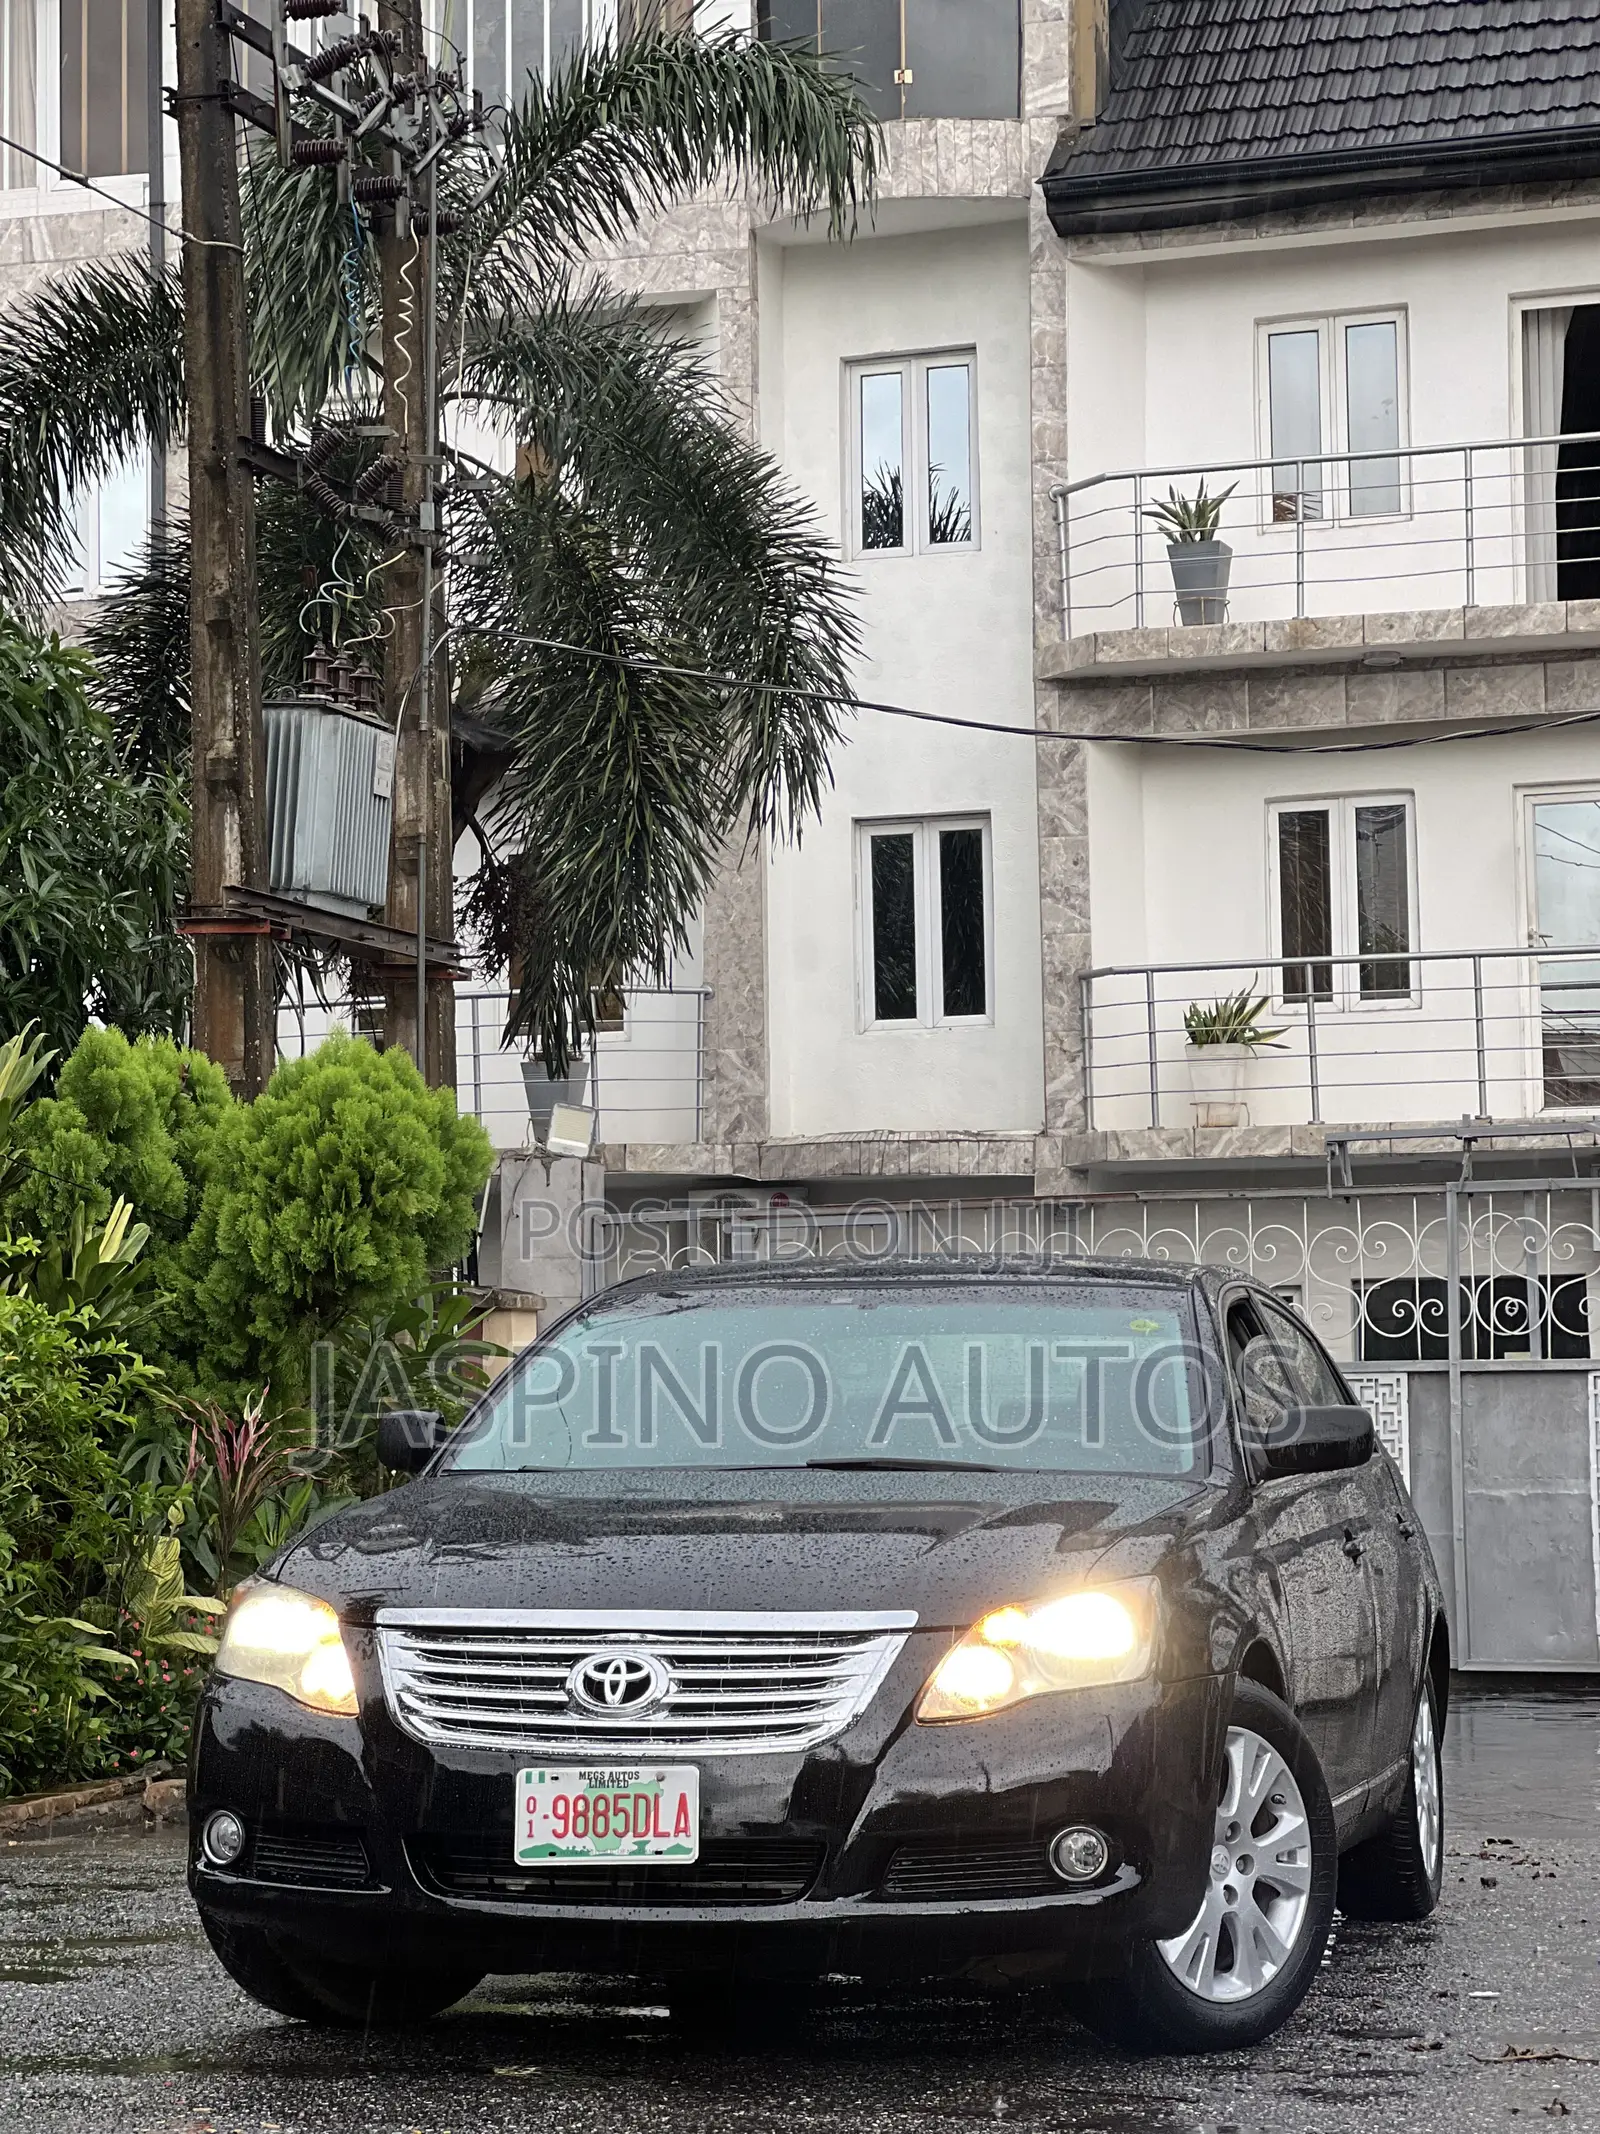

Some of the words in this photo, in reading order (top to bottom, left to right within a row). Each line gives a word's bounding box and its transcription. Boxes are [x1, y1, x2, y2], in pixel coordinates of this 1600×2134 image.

[578, 1771, 605, 1780] MEGS
[608, 1771, 640, 1780] AUTOS
[588, 1779, 630, 1789] LIMITED
